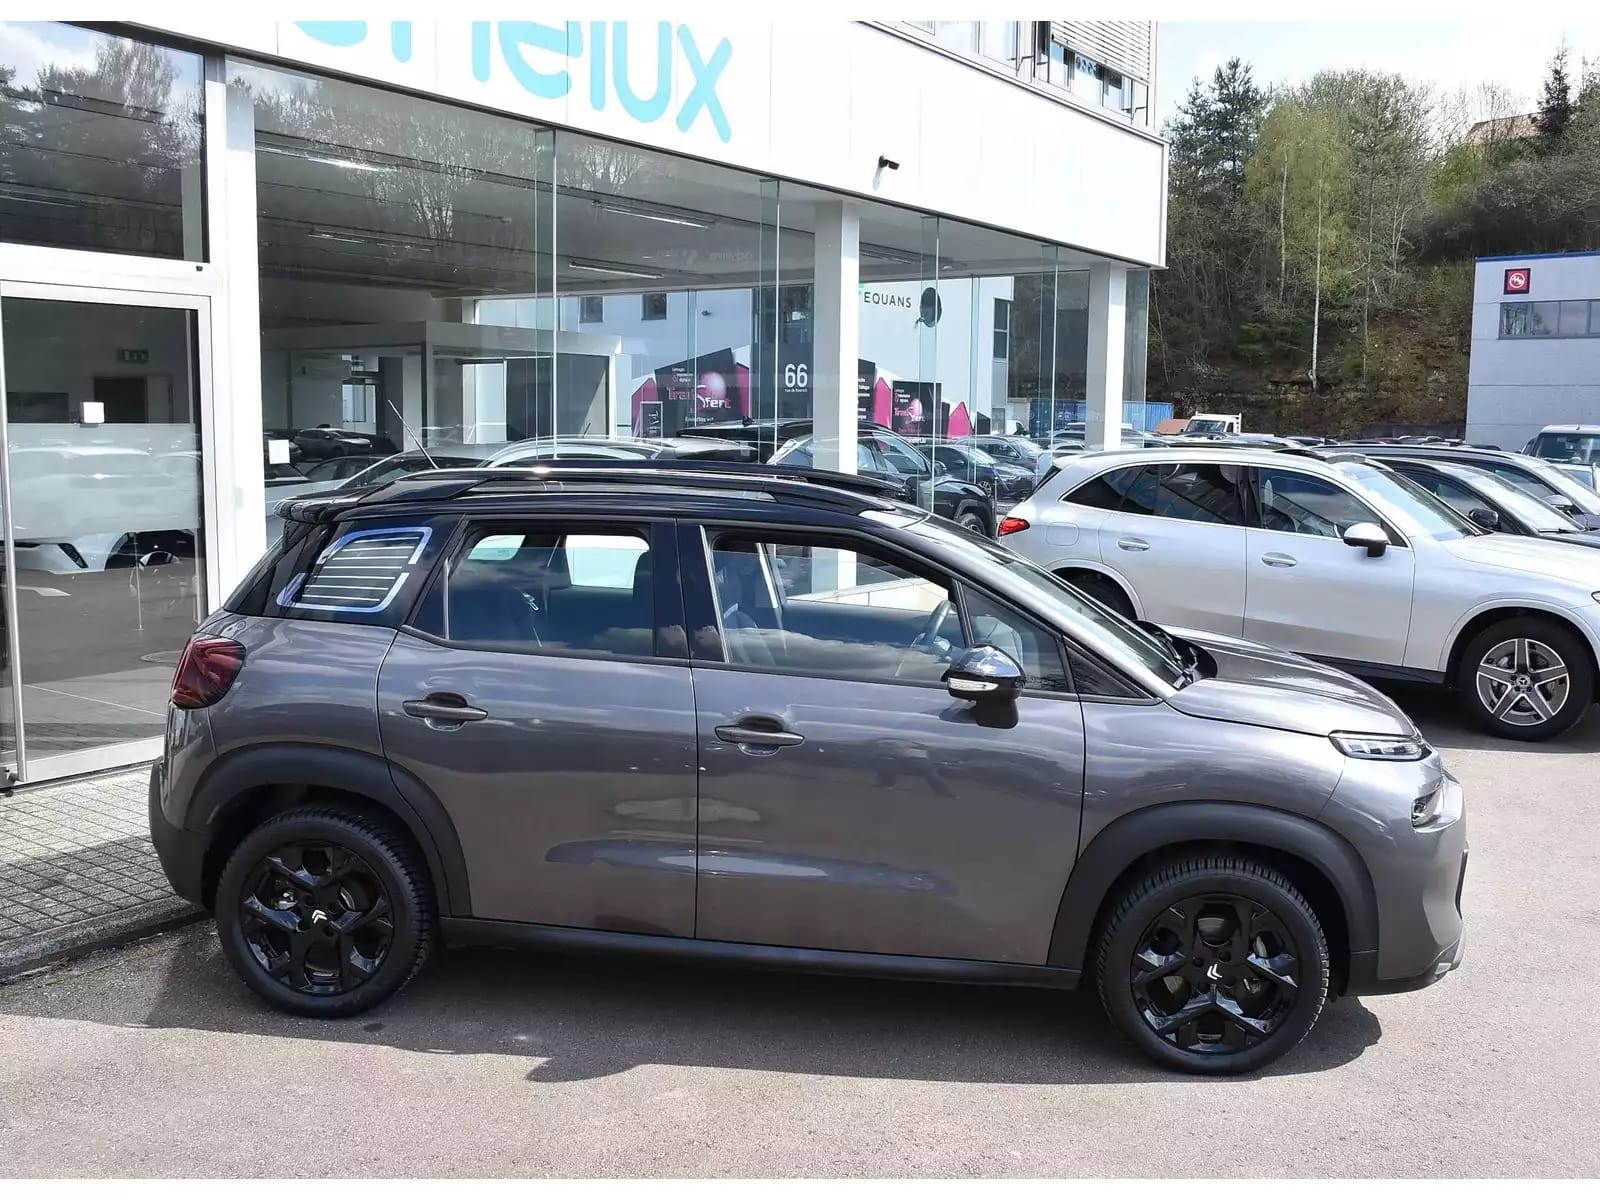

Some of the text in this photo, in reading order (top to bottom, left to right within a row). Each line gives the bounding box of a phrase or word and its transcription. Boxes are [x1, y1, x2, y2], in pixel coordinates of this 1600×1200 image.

[293, 21, 732, 144] elux
[864, 291, 912, 308] EQUANS
[785, 363, 808, 388] 66
